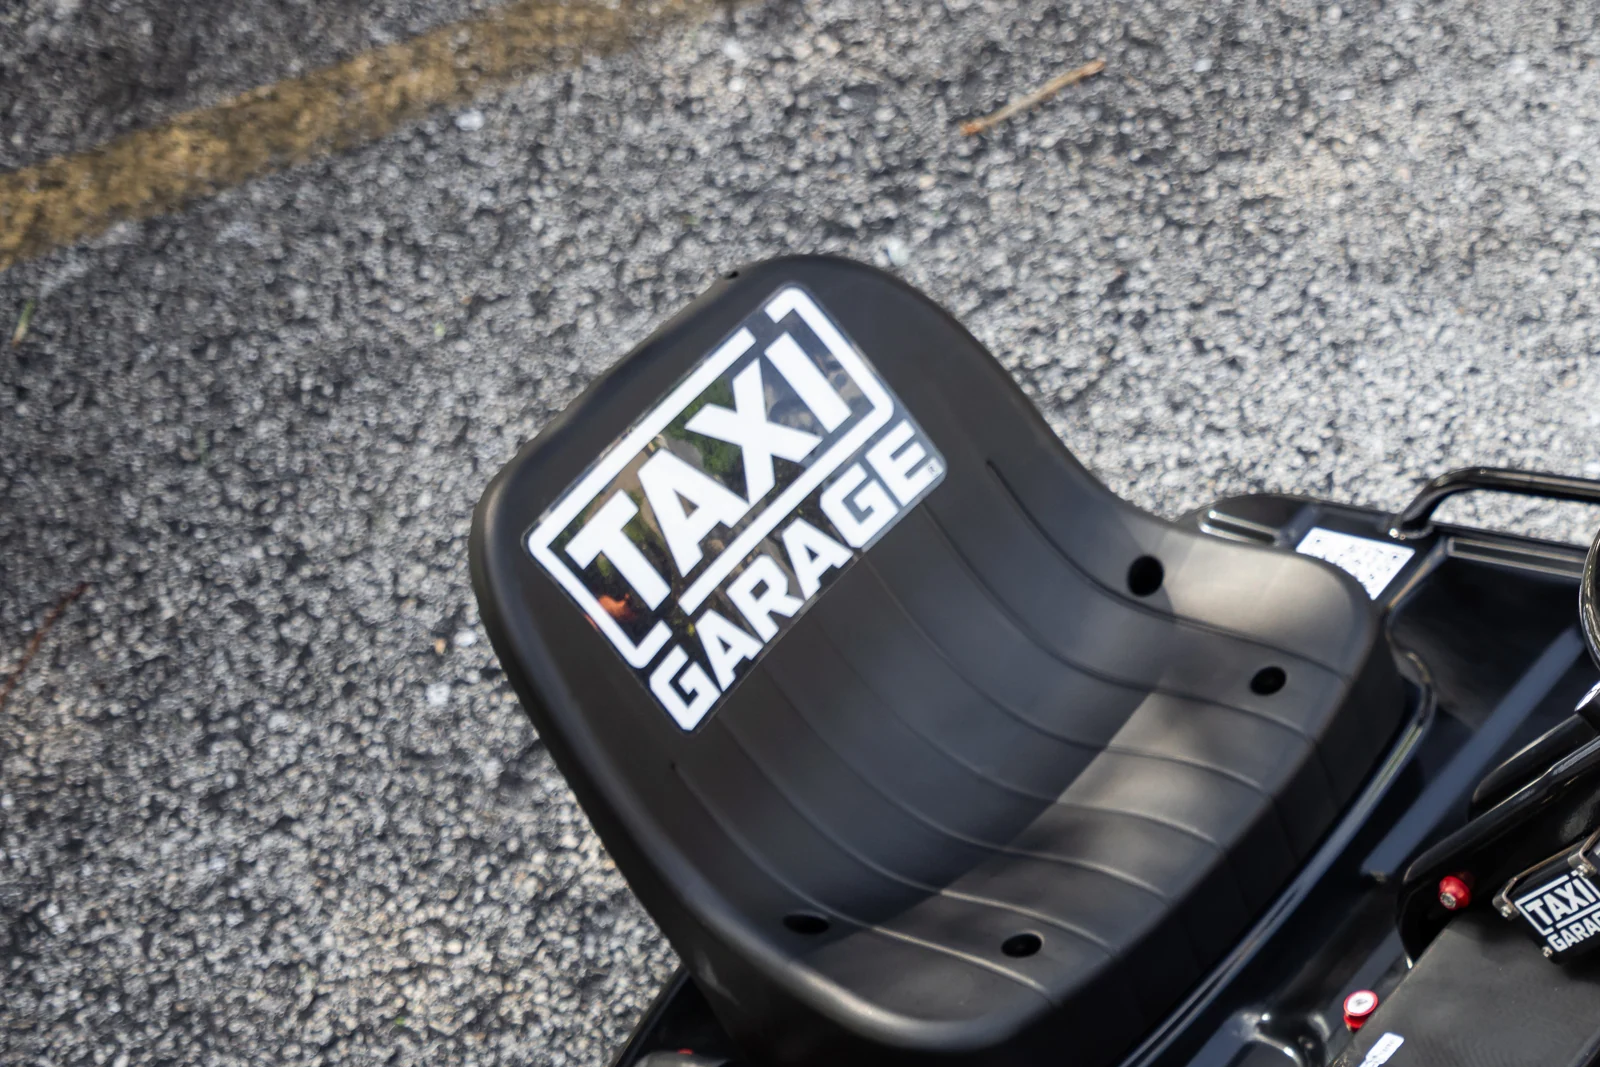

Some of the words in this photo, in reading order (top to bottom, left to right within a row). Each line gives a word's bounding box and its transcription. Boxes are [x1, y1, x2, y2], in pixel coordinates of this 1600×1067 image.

[564, 332, 852, 611] TAXI
[649, 419, 945, 731] GARAGE
[1525, 878, 1597, 926] TAXI
